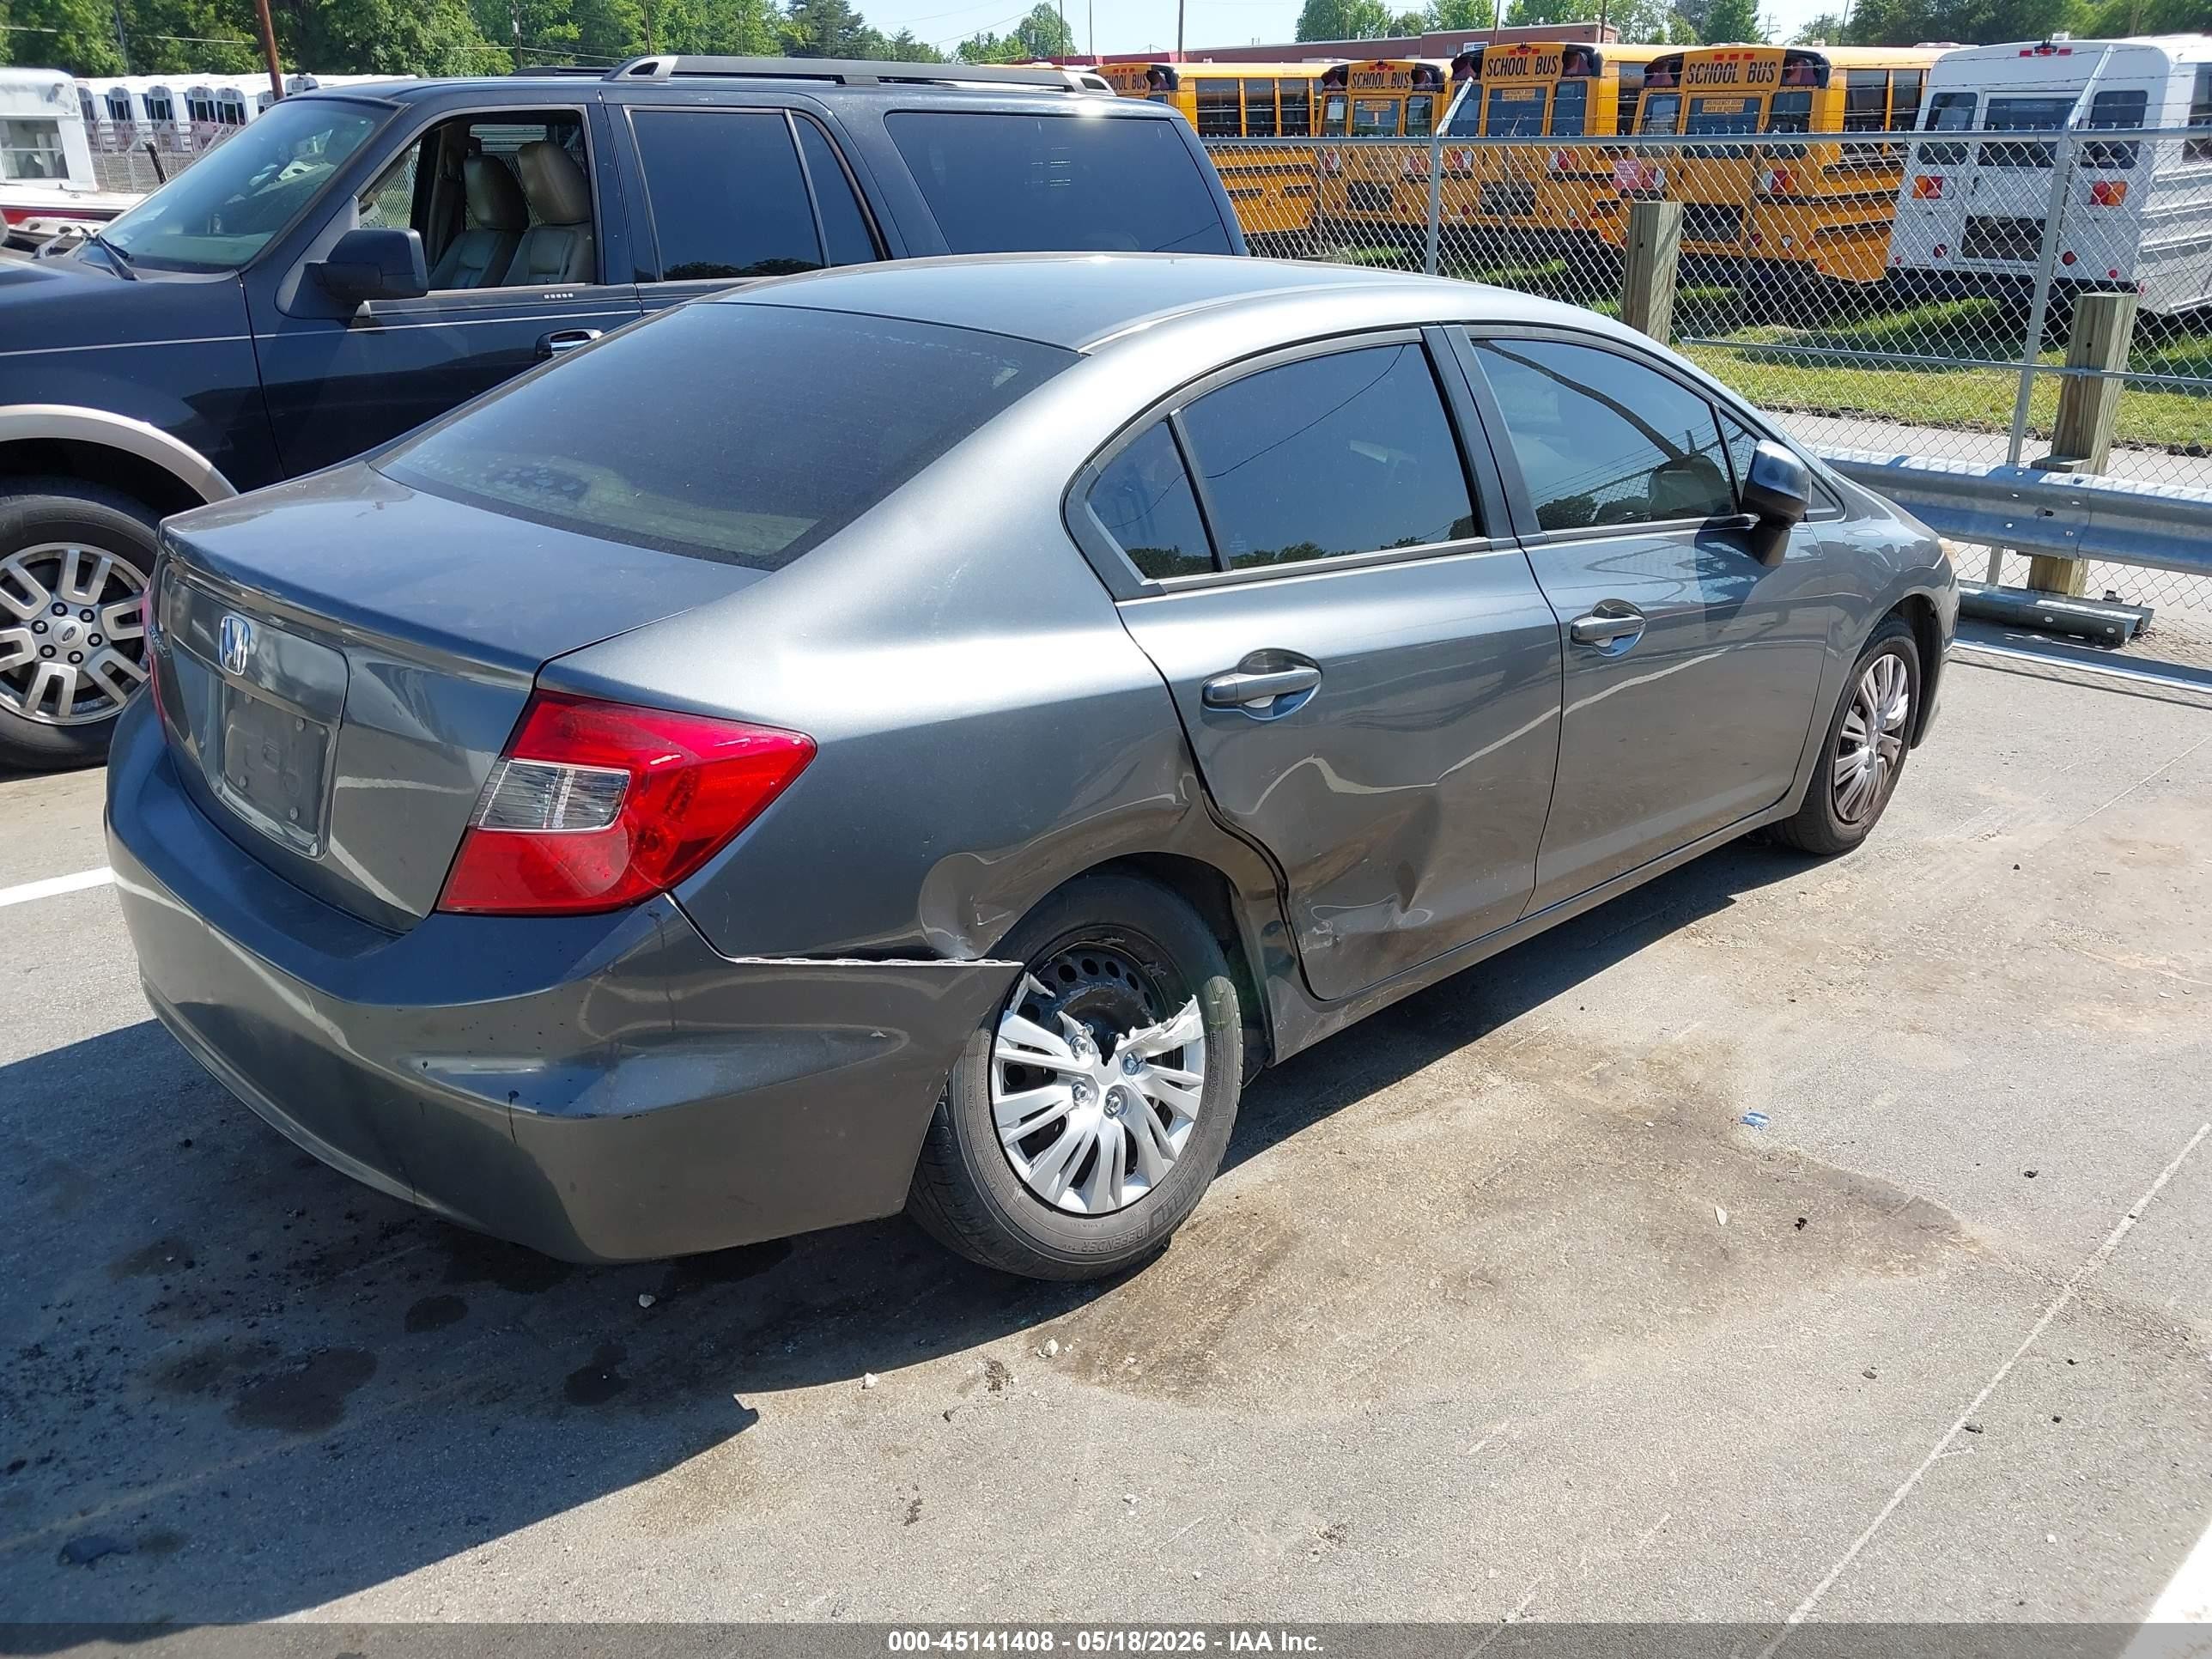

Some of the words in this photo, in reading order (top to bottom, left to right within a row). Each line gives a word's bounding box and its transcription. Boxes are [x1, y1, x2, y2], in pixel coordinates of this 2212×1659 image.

[1486, 57, 1528, 76] SCHOOL
[1534, 55, 1559, 75] BUS
[1686, 62, 1739, 84] SCHOOL
[1747, 61, 1777, 83] BUS
[1105, 74, 1127, 90] HOOL
[1131, 73, 1149, 89] BUS
[1351, 72, 1386, 89] SCHOOL
[1391, 71, 1410, 88] BUS
[1081, 1225, 1146, 1252] DEFENDER
